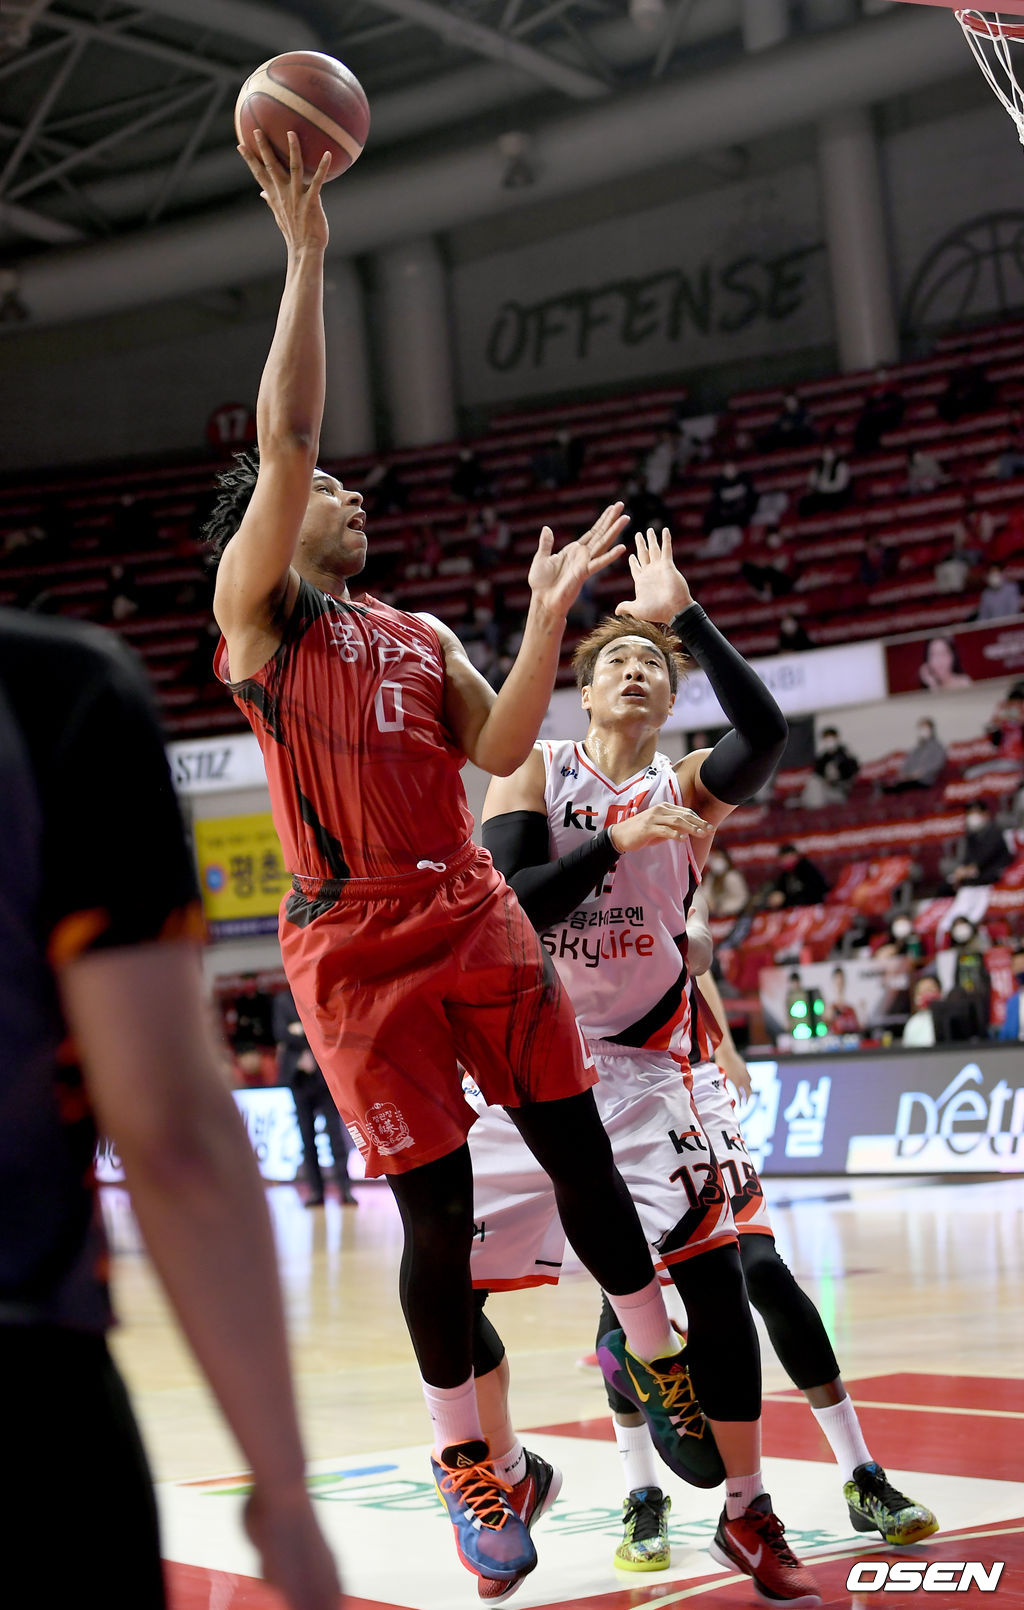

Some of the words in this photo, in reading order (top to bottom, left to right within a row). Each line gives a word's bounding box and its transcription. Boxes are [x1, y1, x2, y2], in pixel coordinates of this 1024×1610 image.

[486, 241, 828, 372] OFFENSE
[216, 409, 248, 441] 17
[373, 679, 405, 733] 0
[563, 801, 599, 831] kt
[540, 929, 655, 968] skylife
[668, 1124, 707, 1155] kt
[669, 1162, 725, 1210] 13
[719, 1159, 763, 1198] 15
